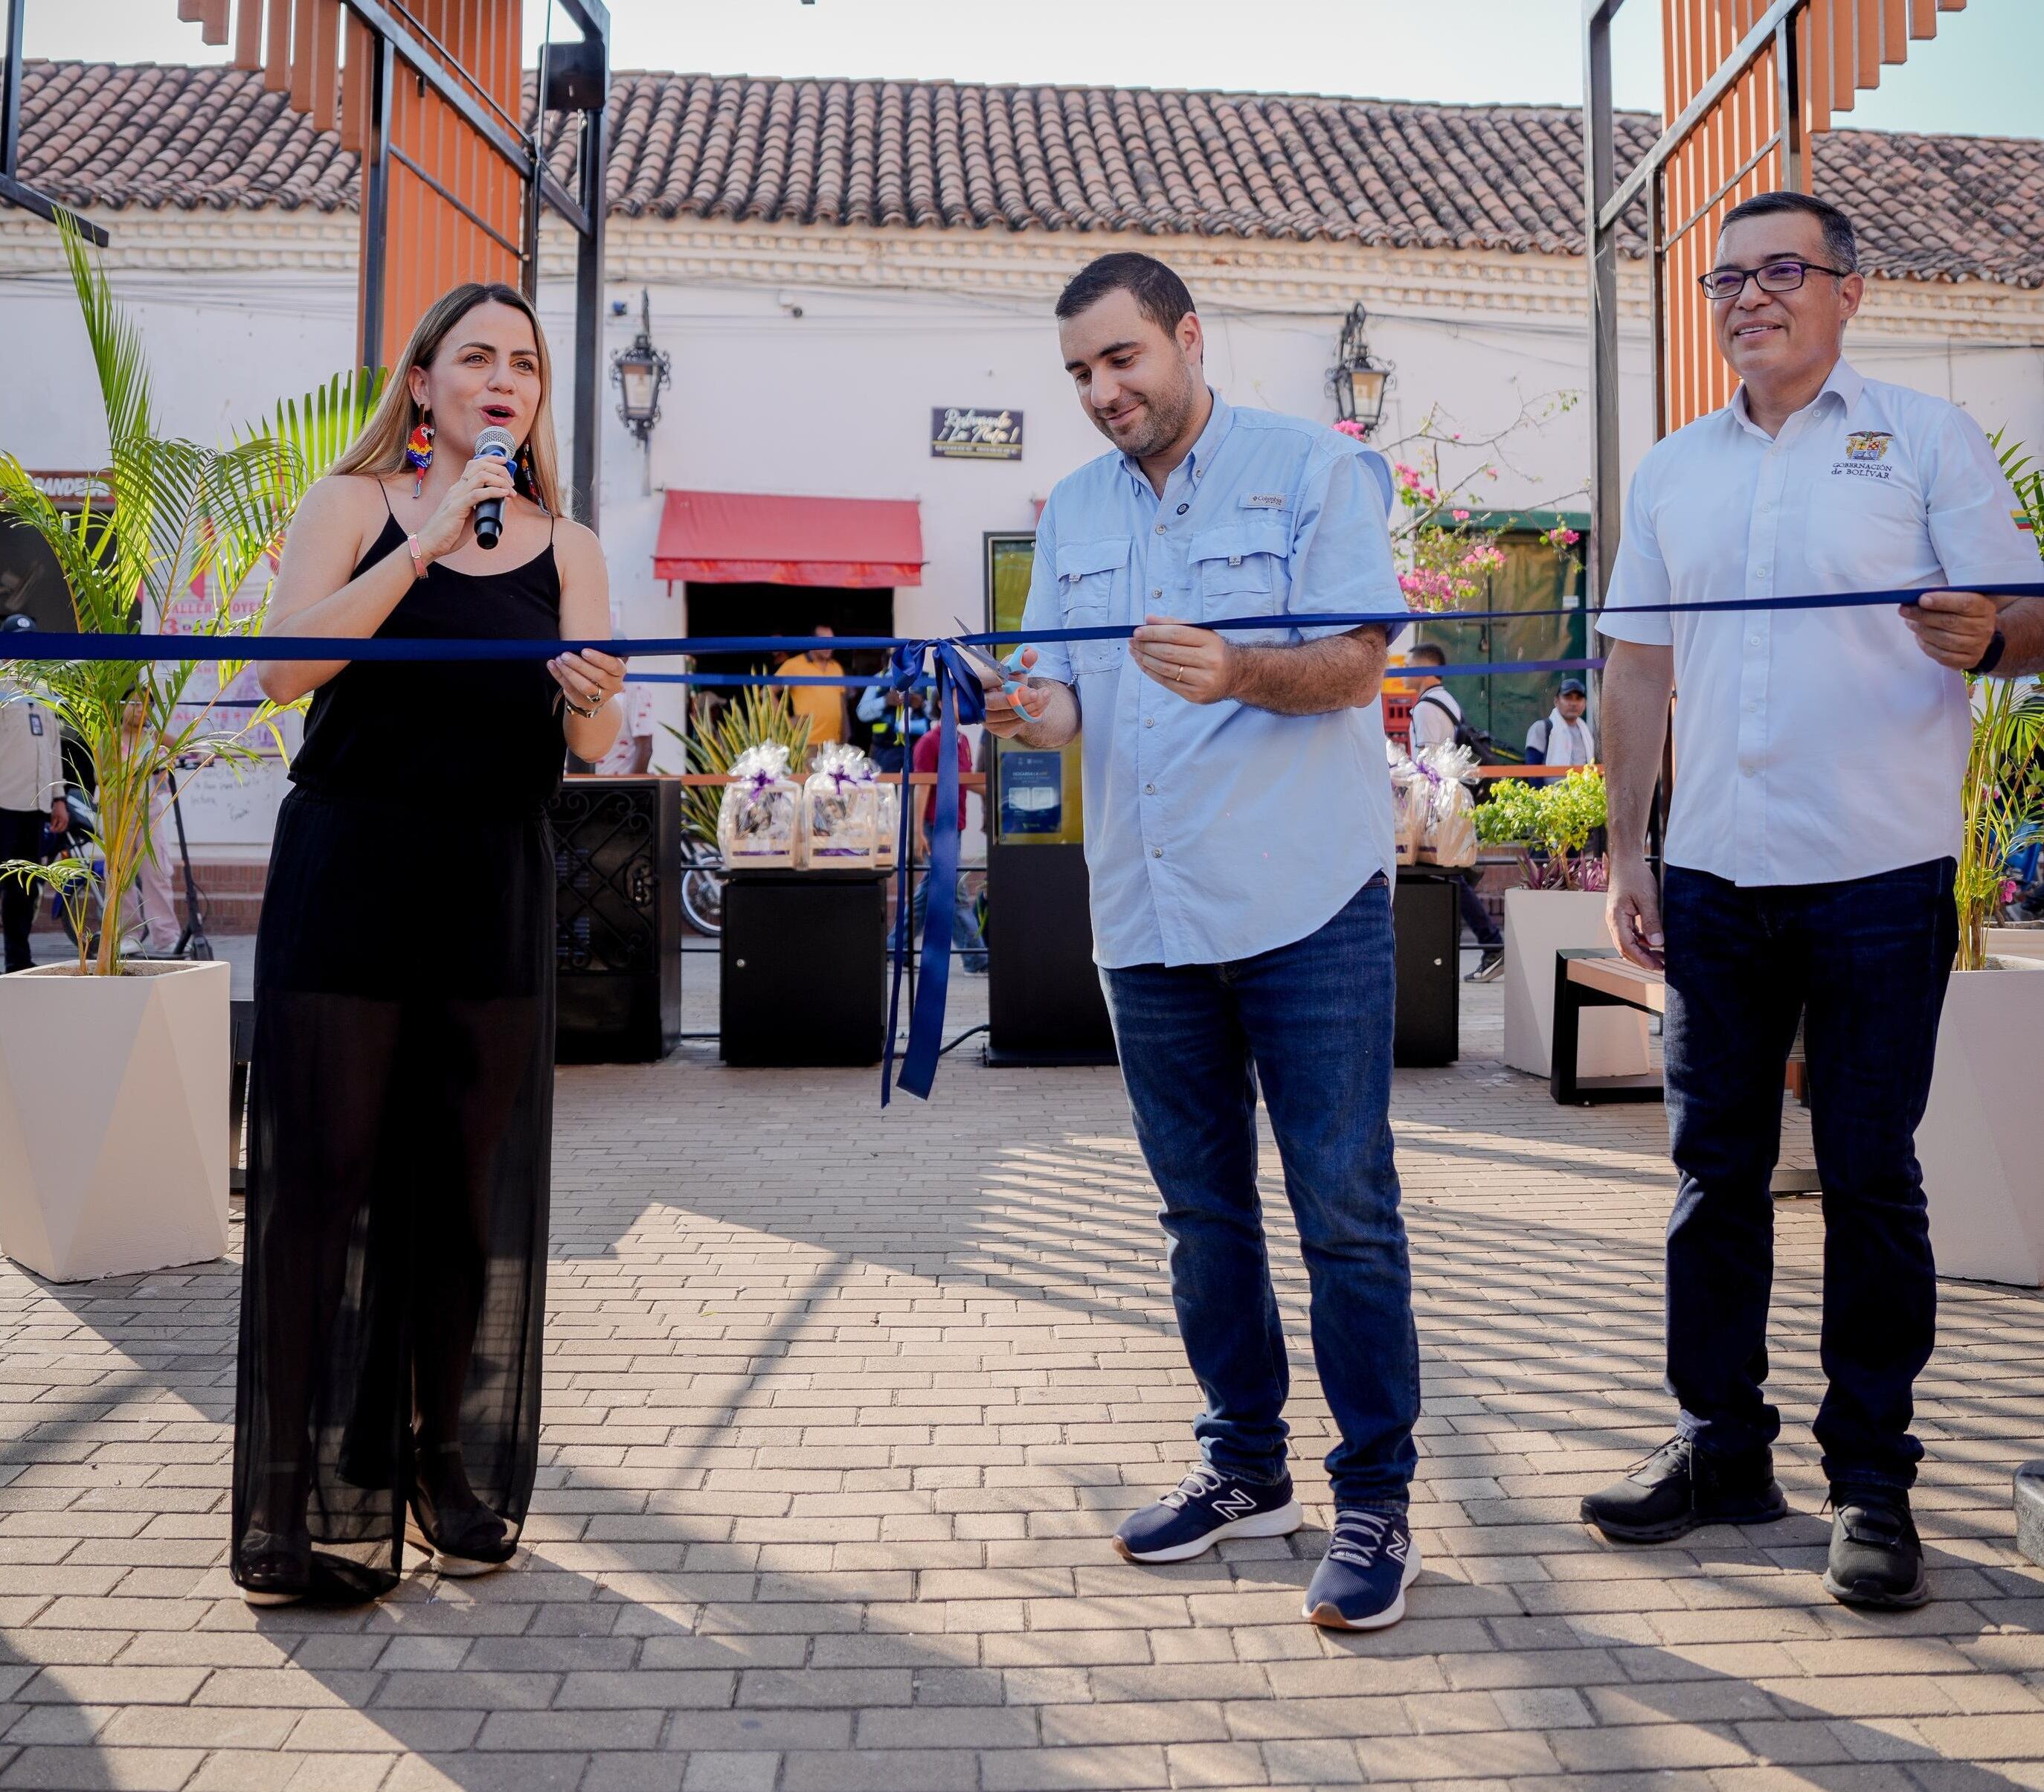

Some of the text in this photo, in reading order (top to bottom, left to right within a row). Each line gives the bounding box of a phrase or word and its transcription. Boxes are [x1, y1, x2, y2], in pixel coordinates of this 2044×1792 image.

[1832, 462, 1892, 472] GOBERNACIÓN
[1846, 469, 1890, 480] BOLÍVAR
[1258, 495, 1282, 504] Columbia
